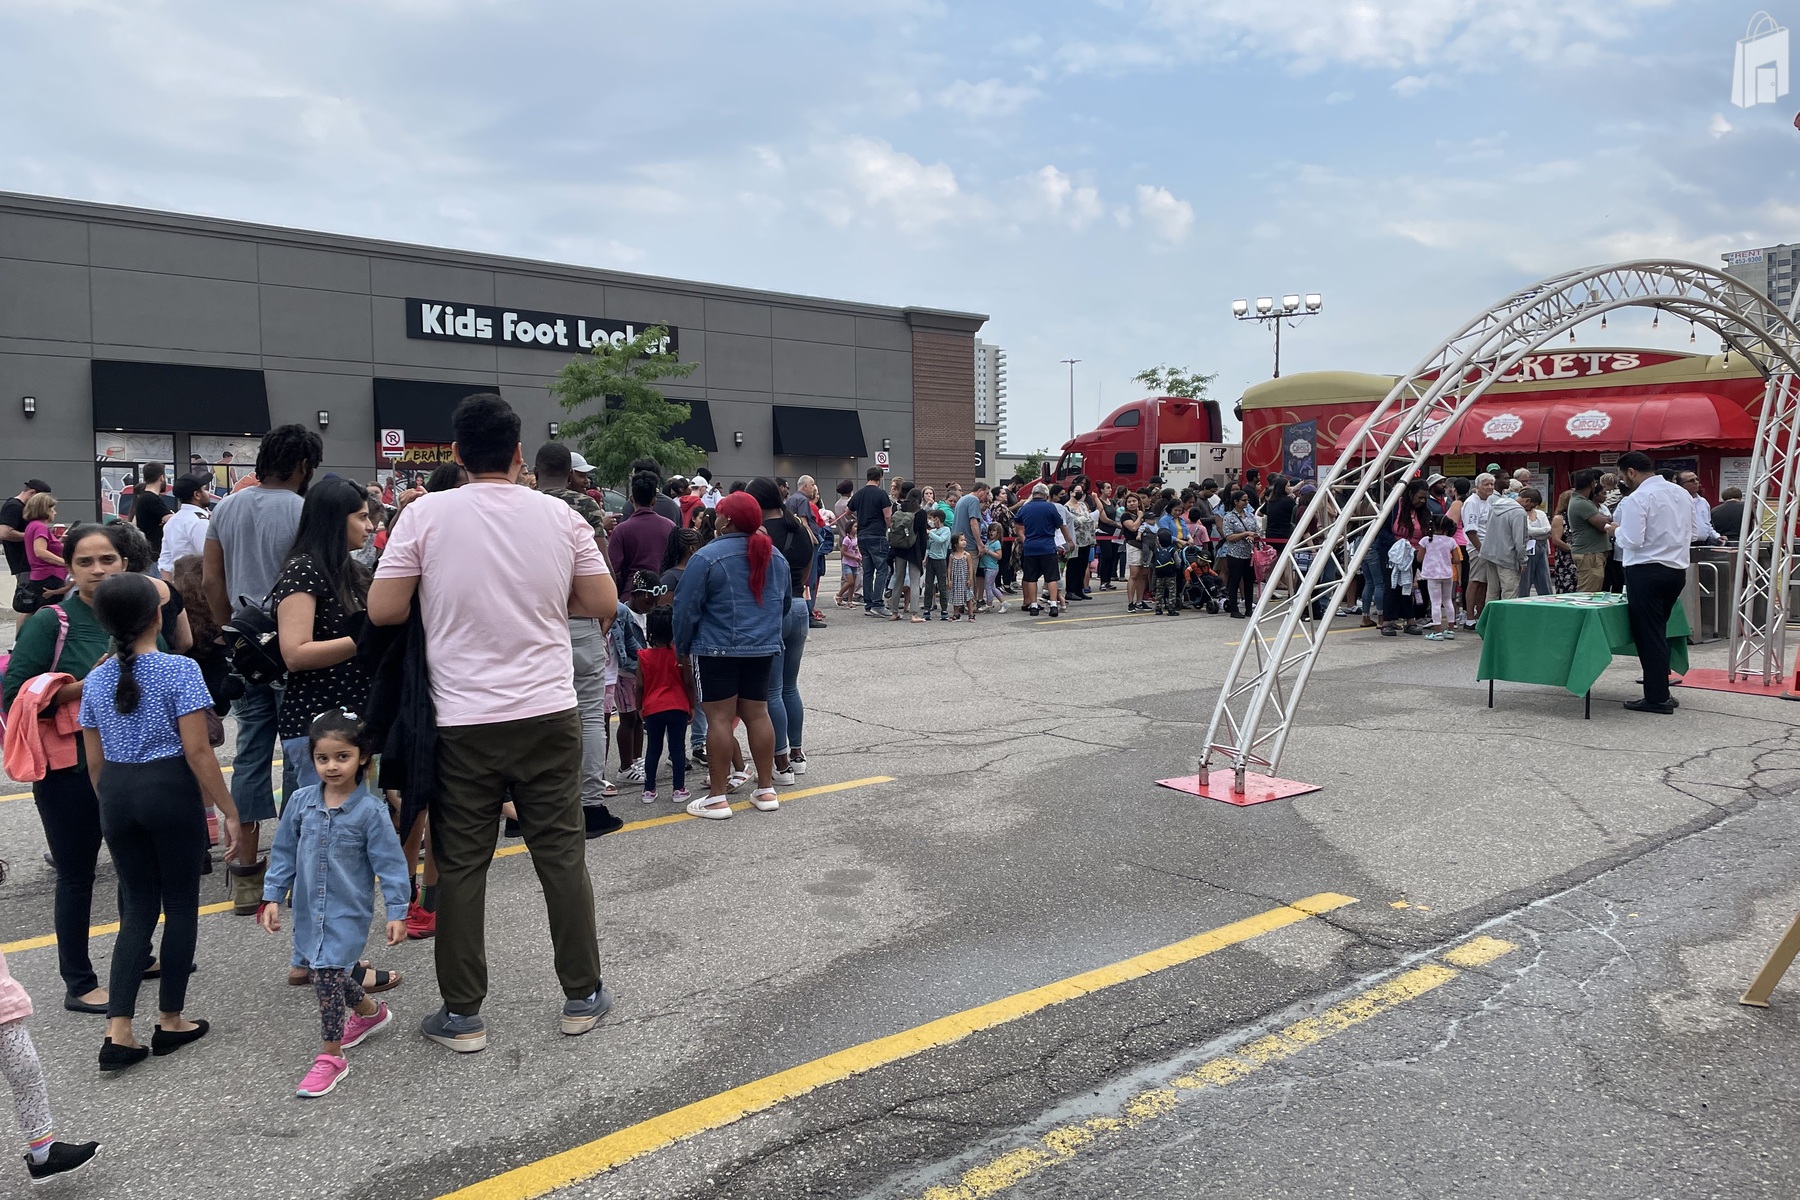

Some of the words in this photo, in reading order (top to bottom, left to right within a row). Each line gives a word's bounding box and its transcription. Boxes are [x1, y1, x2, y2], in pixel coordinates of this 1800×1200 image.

[1734, 249, 1760, 258] RENT
[421, 303, 492, 338] Kids
[503, 312, 568, 346] Foot
[1455, 352, 1641, 383] ICKETS
[413, 450, 454, 462] BRAMP
